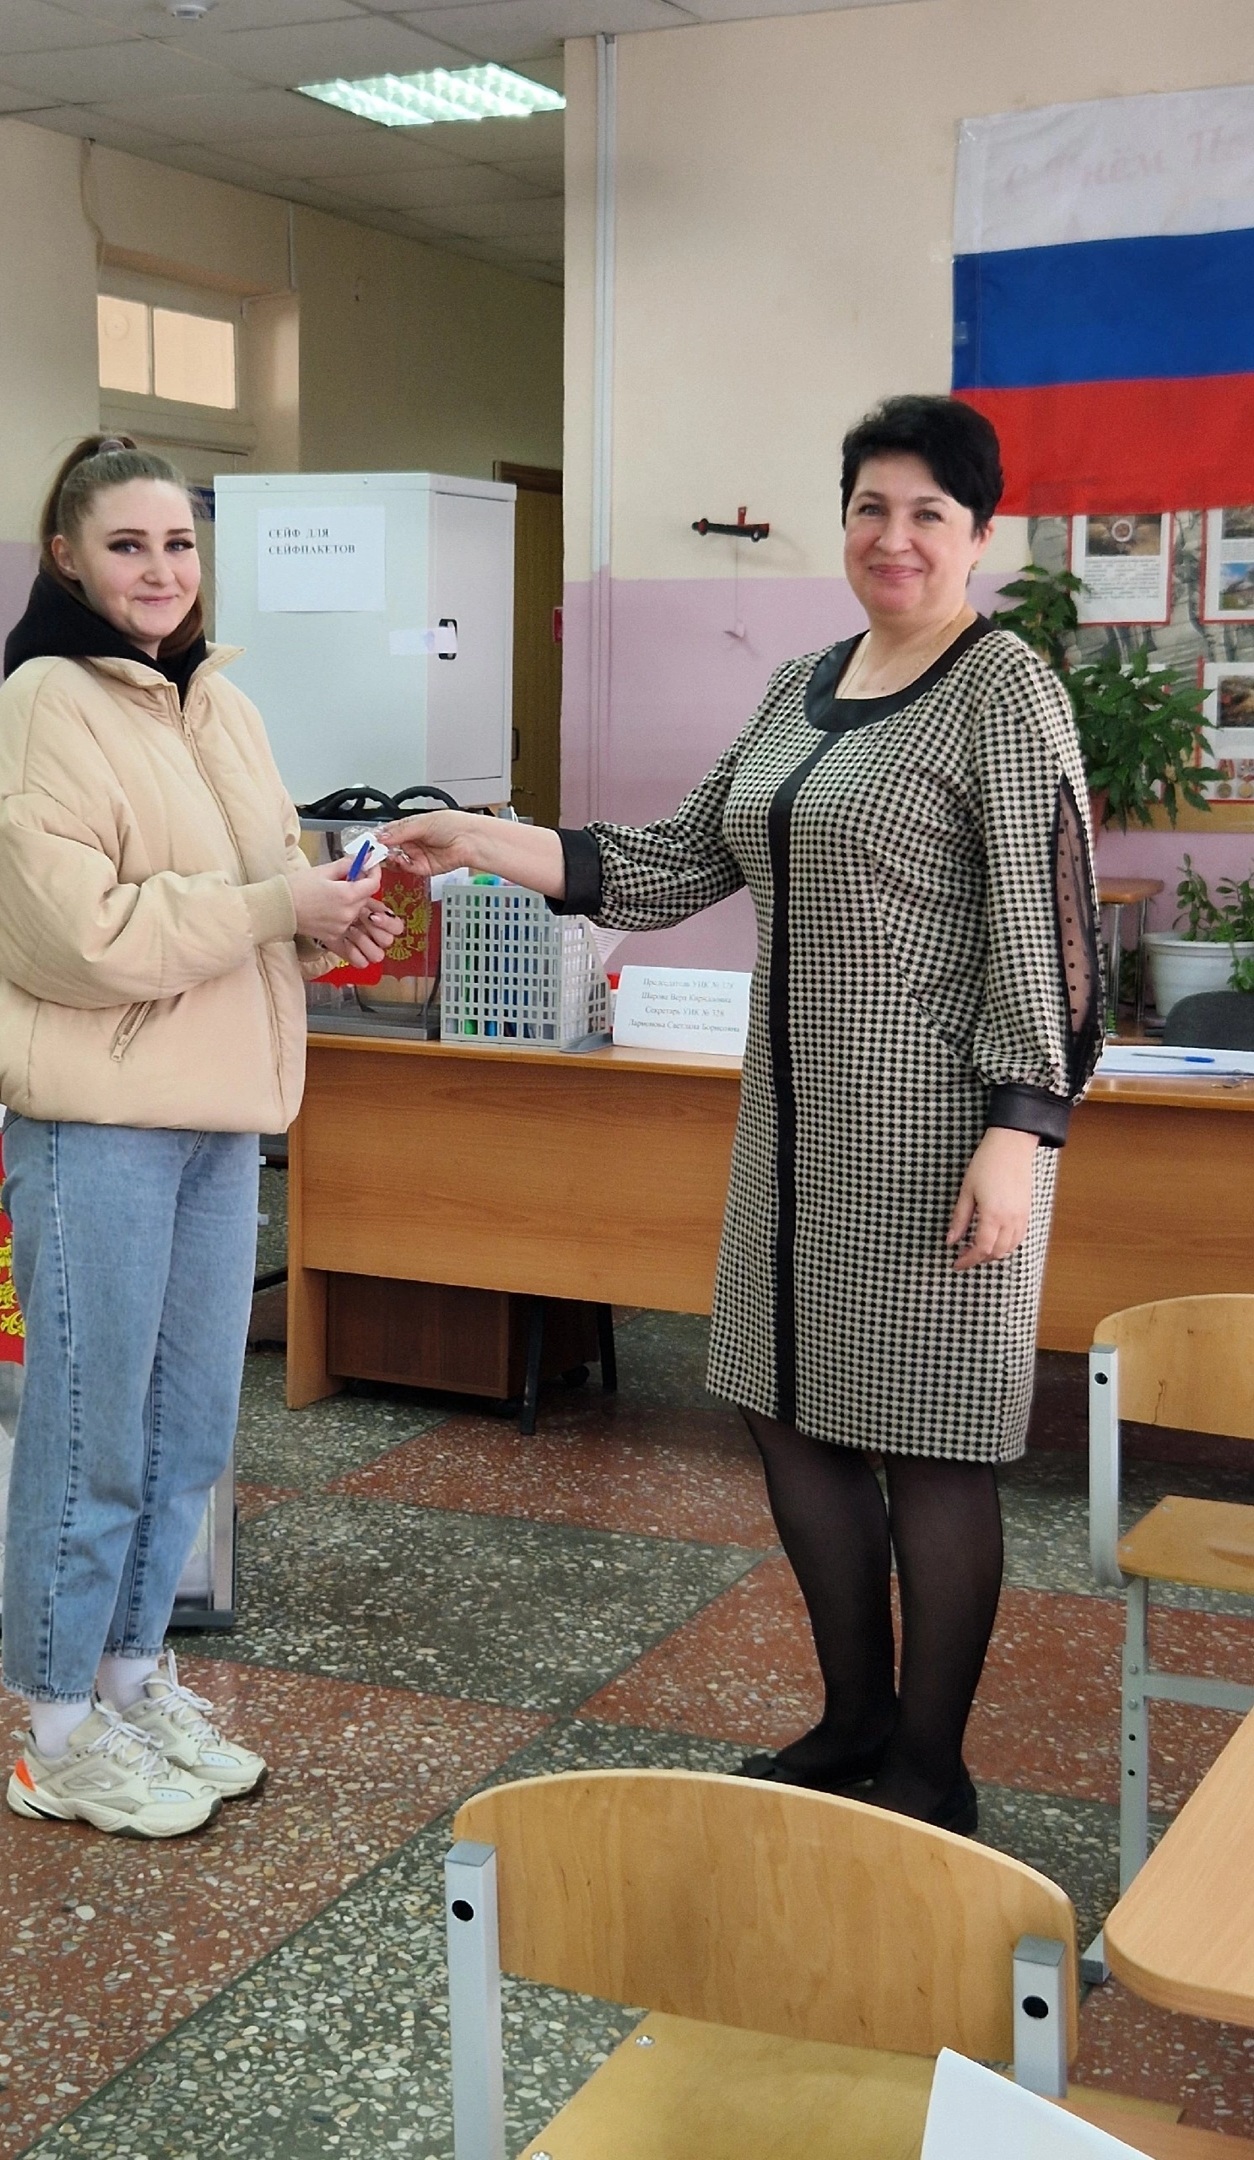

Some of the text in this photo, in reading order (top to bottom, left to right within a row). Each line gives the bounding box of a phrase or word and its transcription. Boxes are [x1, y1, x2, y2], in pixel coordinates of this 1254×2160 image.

[268, 527, 329, 539] СЕЙФ ДЛЯ
[268, 544, 355, 554] СЕЙФПАКЕТОВ
[645, 1006, 680, 1016] Секретарь
[683, 1007, 699, 1016] УИК
[702, 1008, 710, 1016] №
[667, 1021, 700, 1031] Светлана
[702, 1023, 740, 1033] Борисовна
